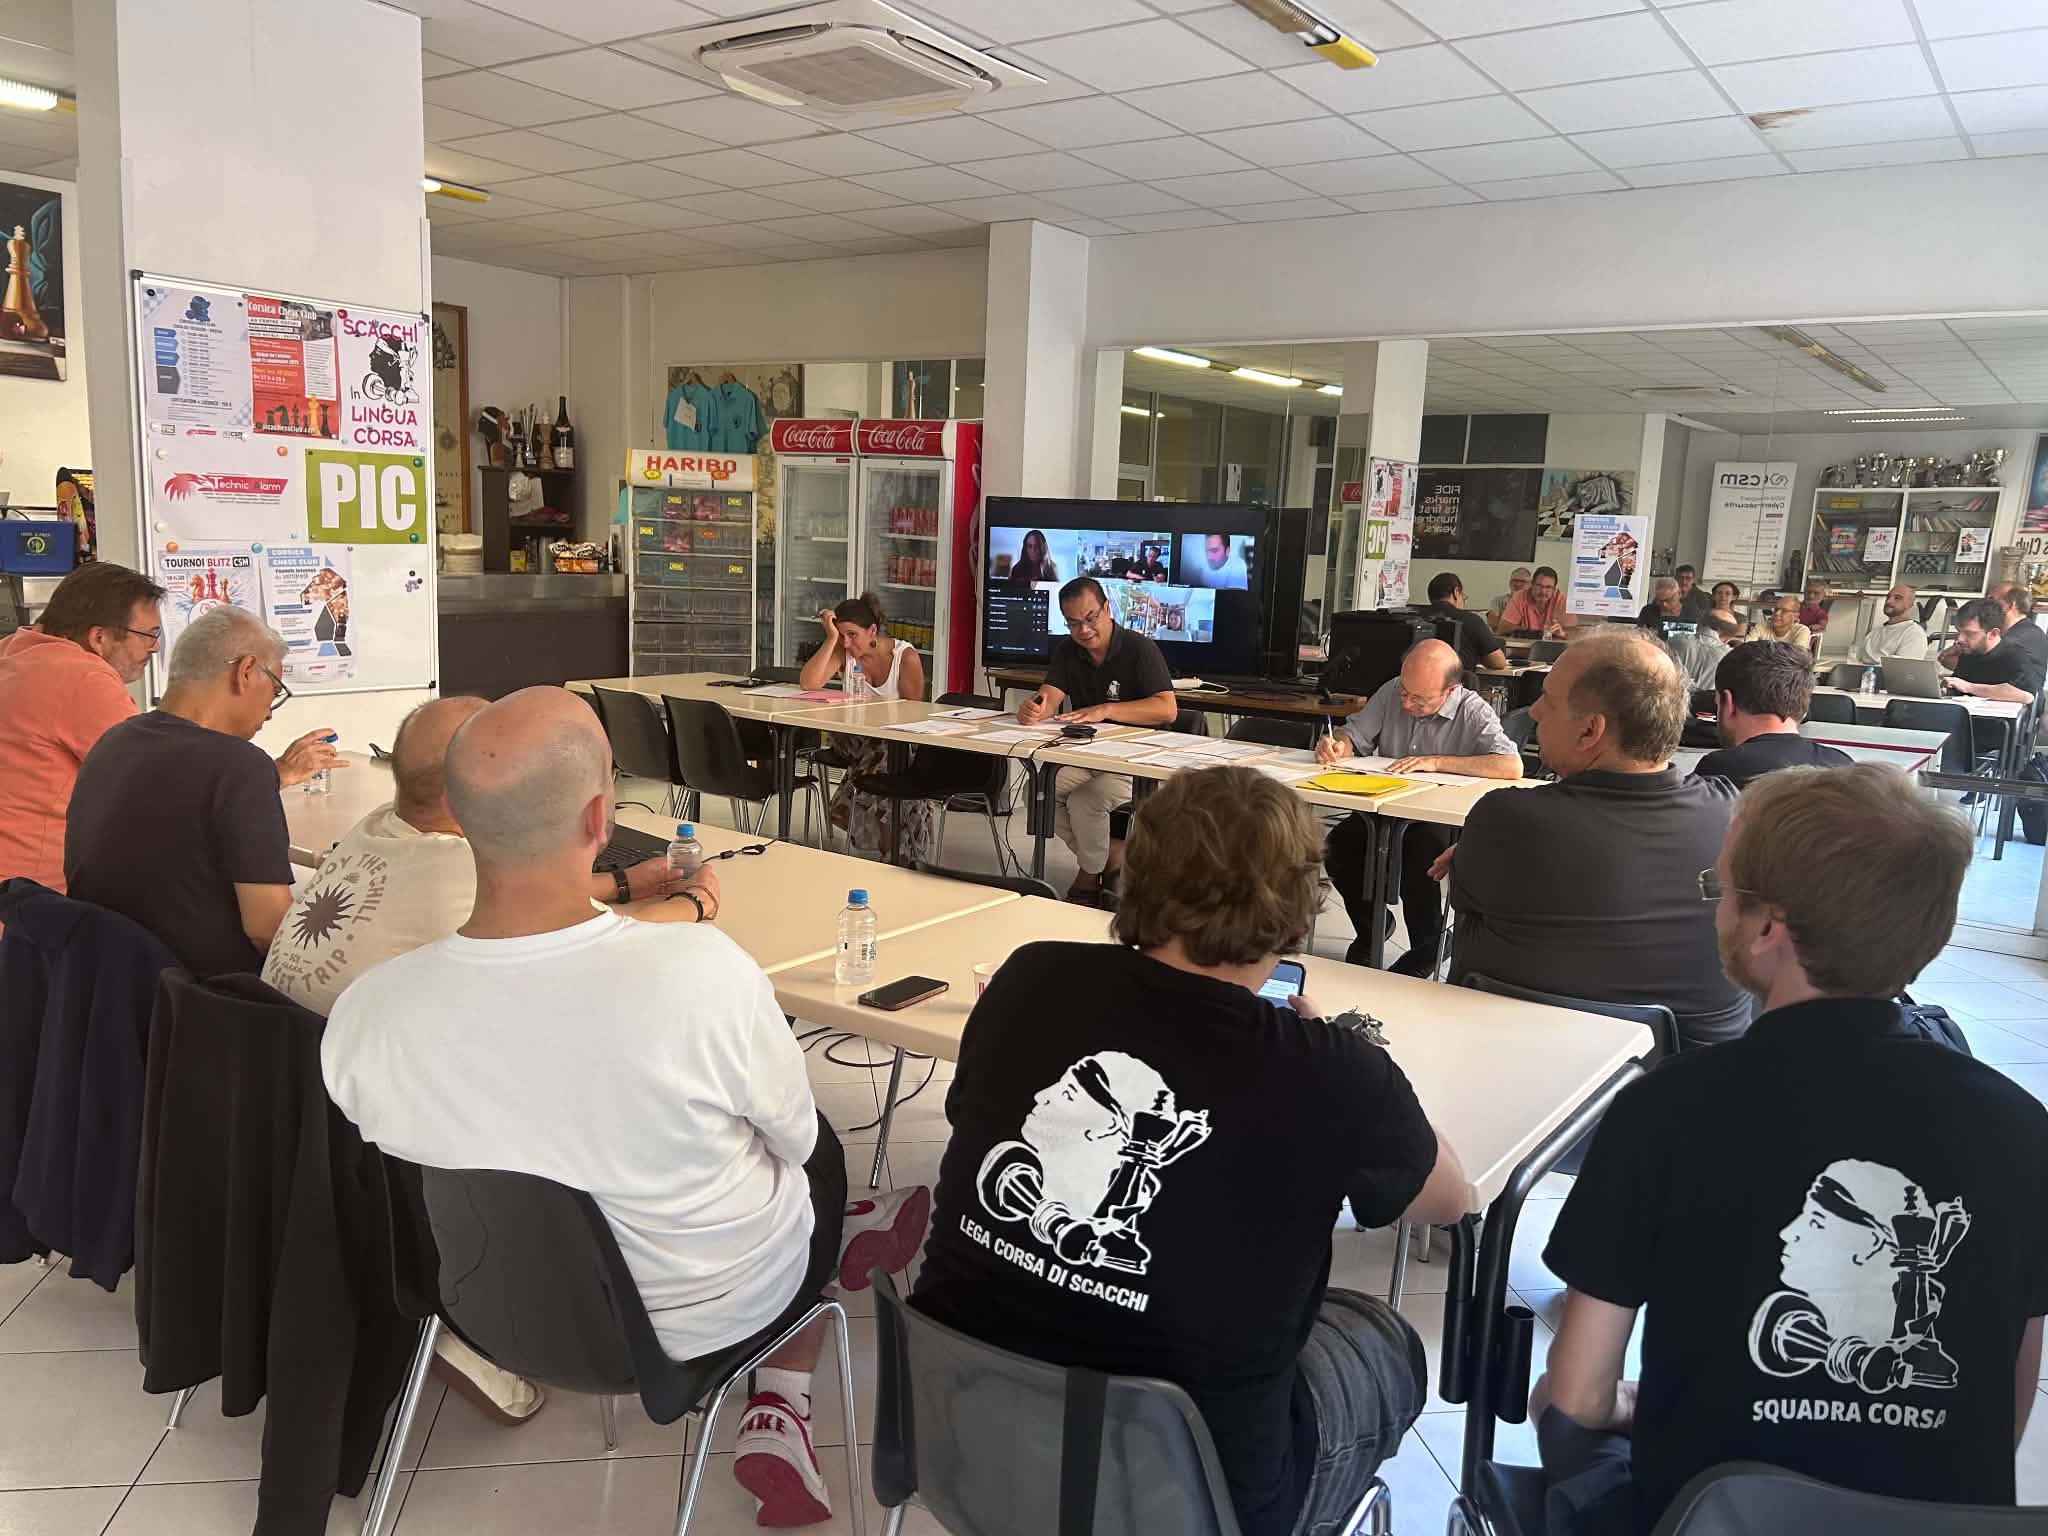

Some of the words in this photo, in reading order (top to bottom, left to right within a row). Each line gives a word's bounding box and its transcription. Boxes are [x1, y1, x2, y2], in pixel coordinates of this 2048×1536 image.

[343, 318, 418, 343] SCACCHI
[351, 405, 418, 426] LINGUA
[353, 428, 416, 447] CORSA
[783, 424, 840, 449] Coca-Cola
[868, 424, 929, 450] Coca-Cola
[646, 456, 737, 474] HARIBO
[210, 477, 249, 490] Technic
[320, 462, 417, 531] PIC
[165, 558, 205, 568] TOURNOI
[207, 558, 231, 568] BLITZ
[302, 948, 348, 992] TRIP
[960, 1214, 991, 1249] LEGA
[993, 1238, 1045, 1278] CORSA
[1047, 1263, 1067, 1287] DI
[1068, 1274, 1149, 1312] SCACCHI
[1752, 1400, 1861, 1423] SQUADRA
[1868, 1403, 1947, 1429] CORSA
